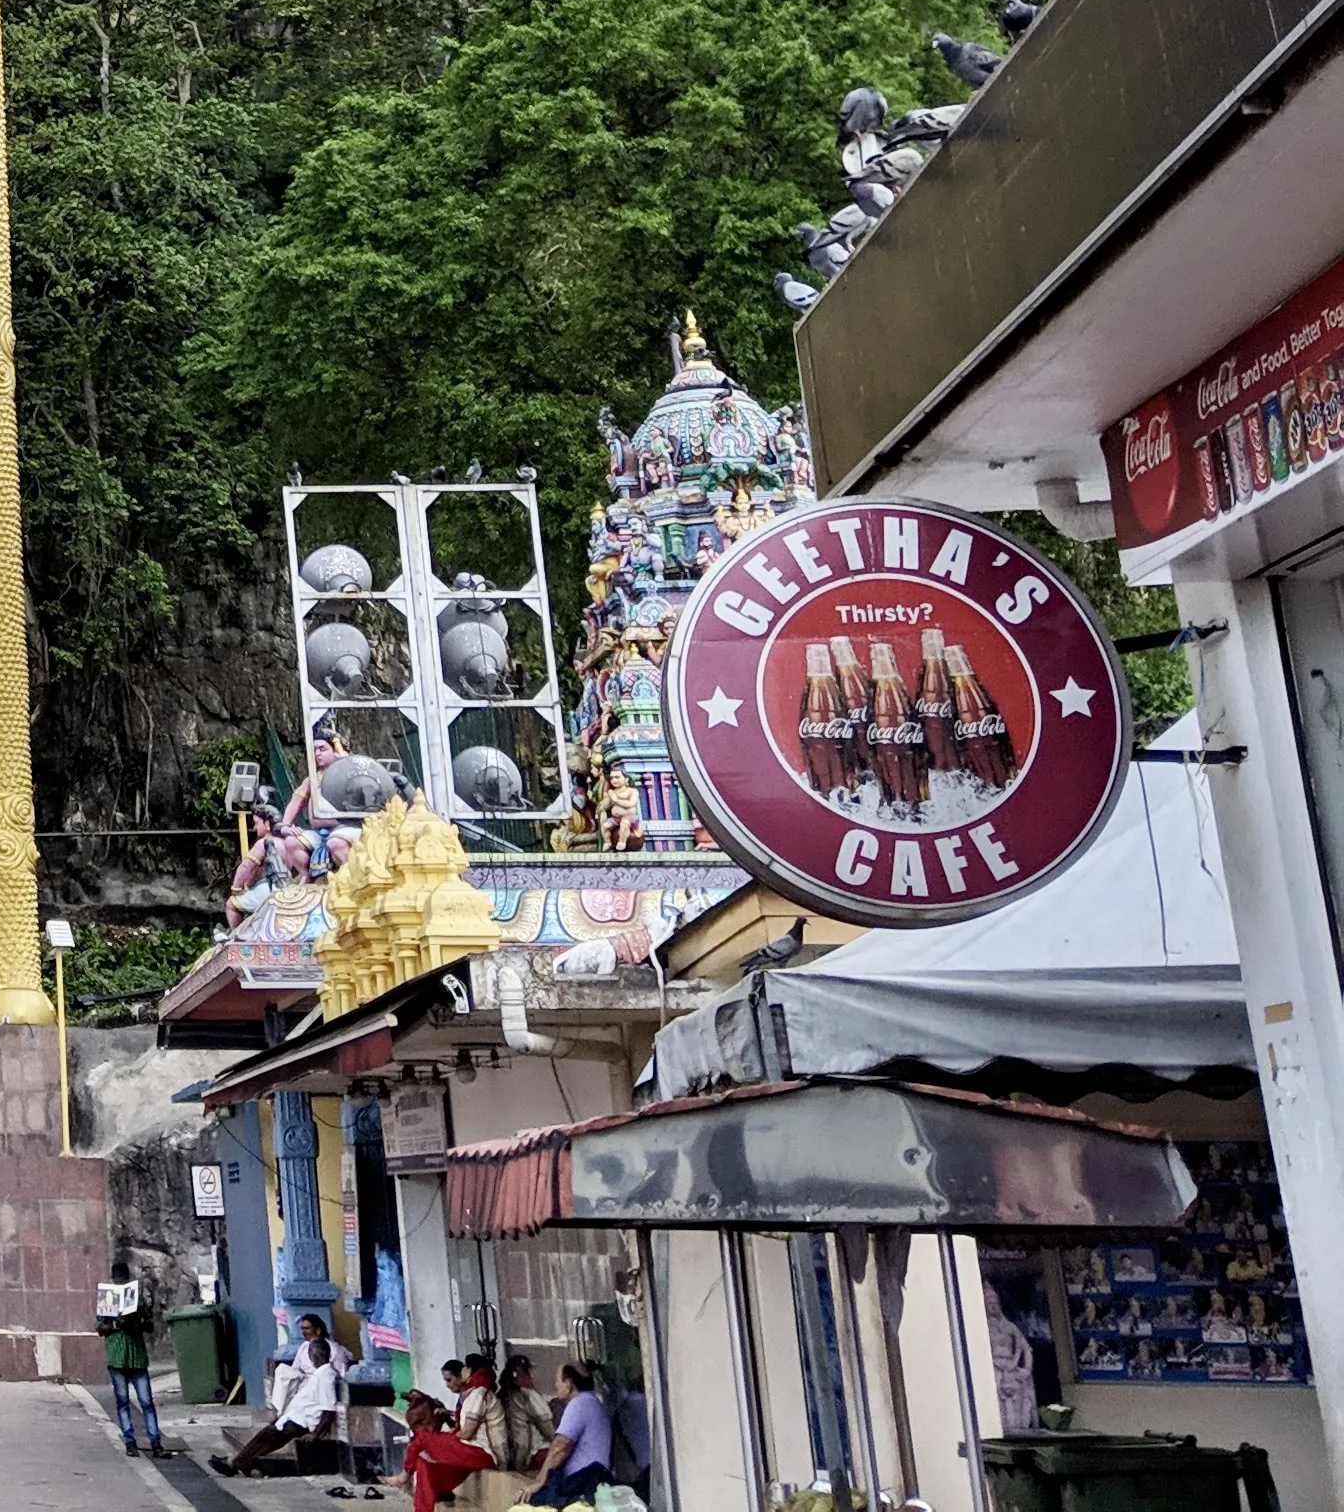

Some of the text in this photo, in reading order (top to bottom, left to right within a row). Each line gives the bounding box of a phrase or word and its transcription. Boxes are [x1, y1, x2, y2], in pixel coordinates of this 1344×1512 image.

[1241, 359, 1261, 389] and
[1261, 341, 1291, 377] Food.
[1290, 319, 1321, 355] Better
[1125, 410, 1172, 483] Coca-Cola
[713, 516, 1050, 637] GEETHA'S
[835, 603, 934, 625] Thirsty?
[799, 717, 854, 739] Coca-Cola
[867, 722, 924, 746] Coca-Cola
[954, 714, 1006, 741] Coca-Cola
[835, 821, 1020, 897] CAFE
